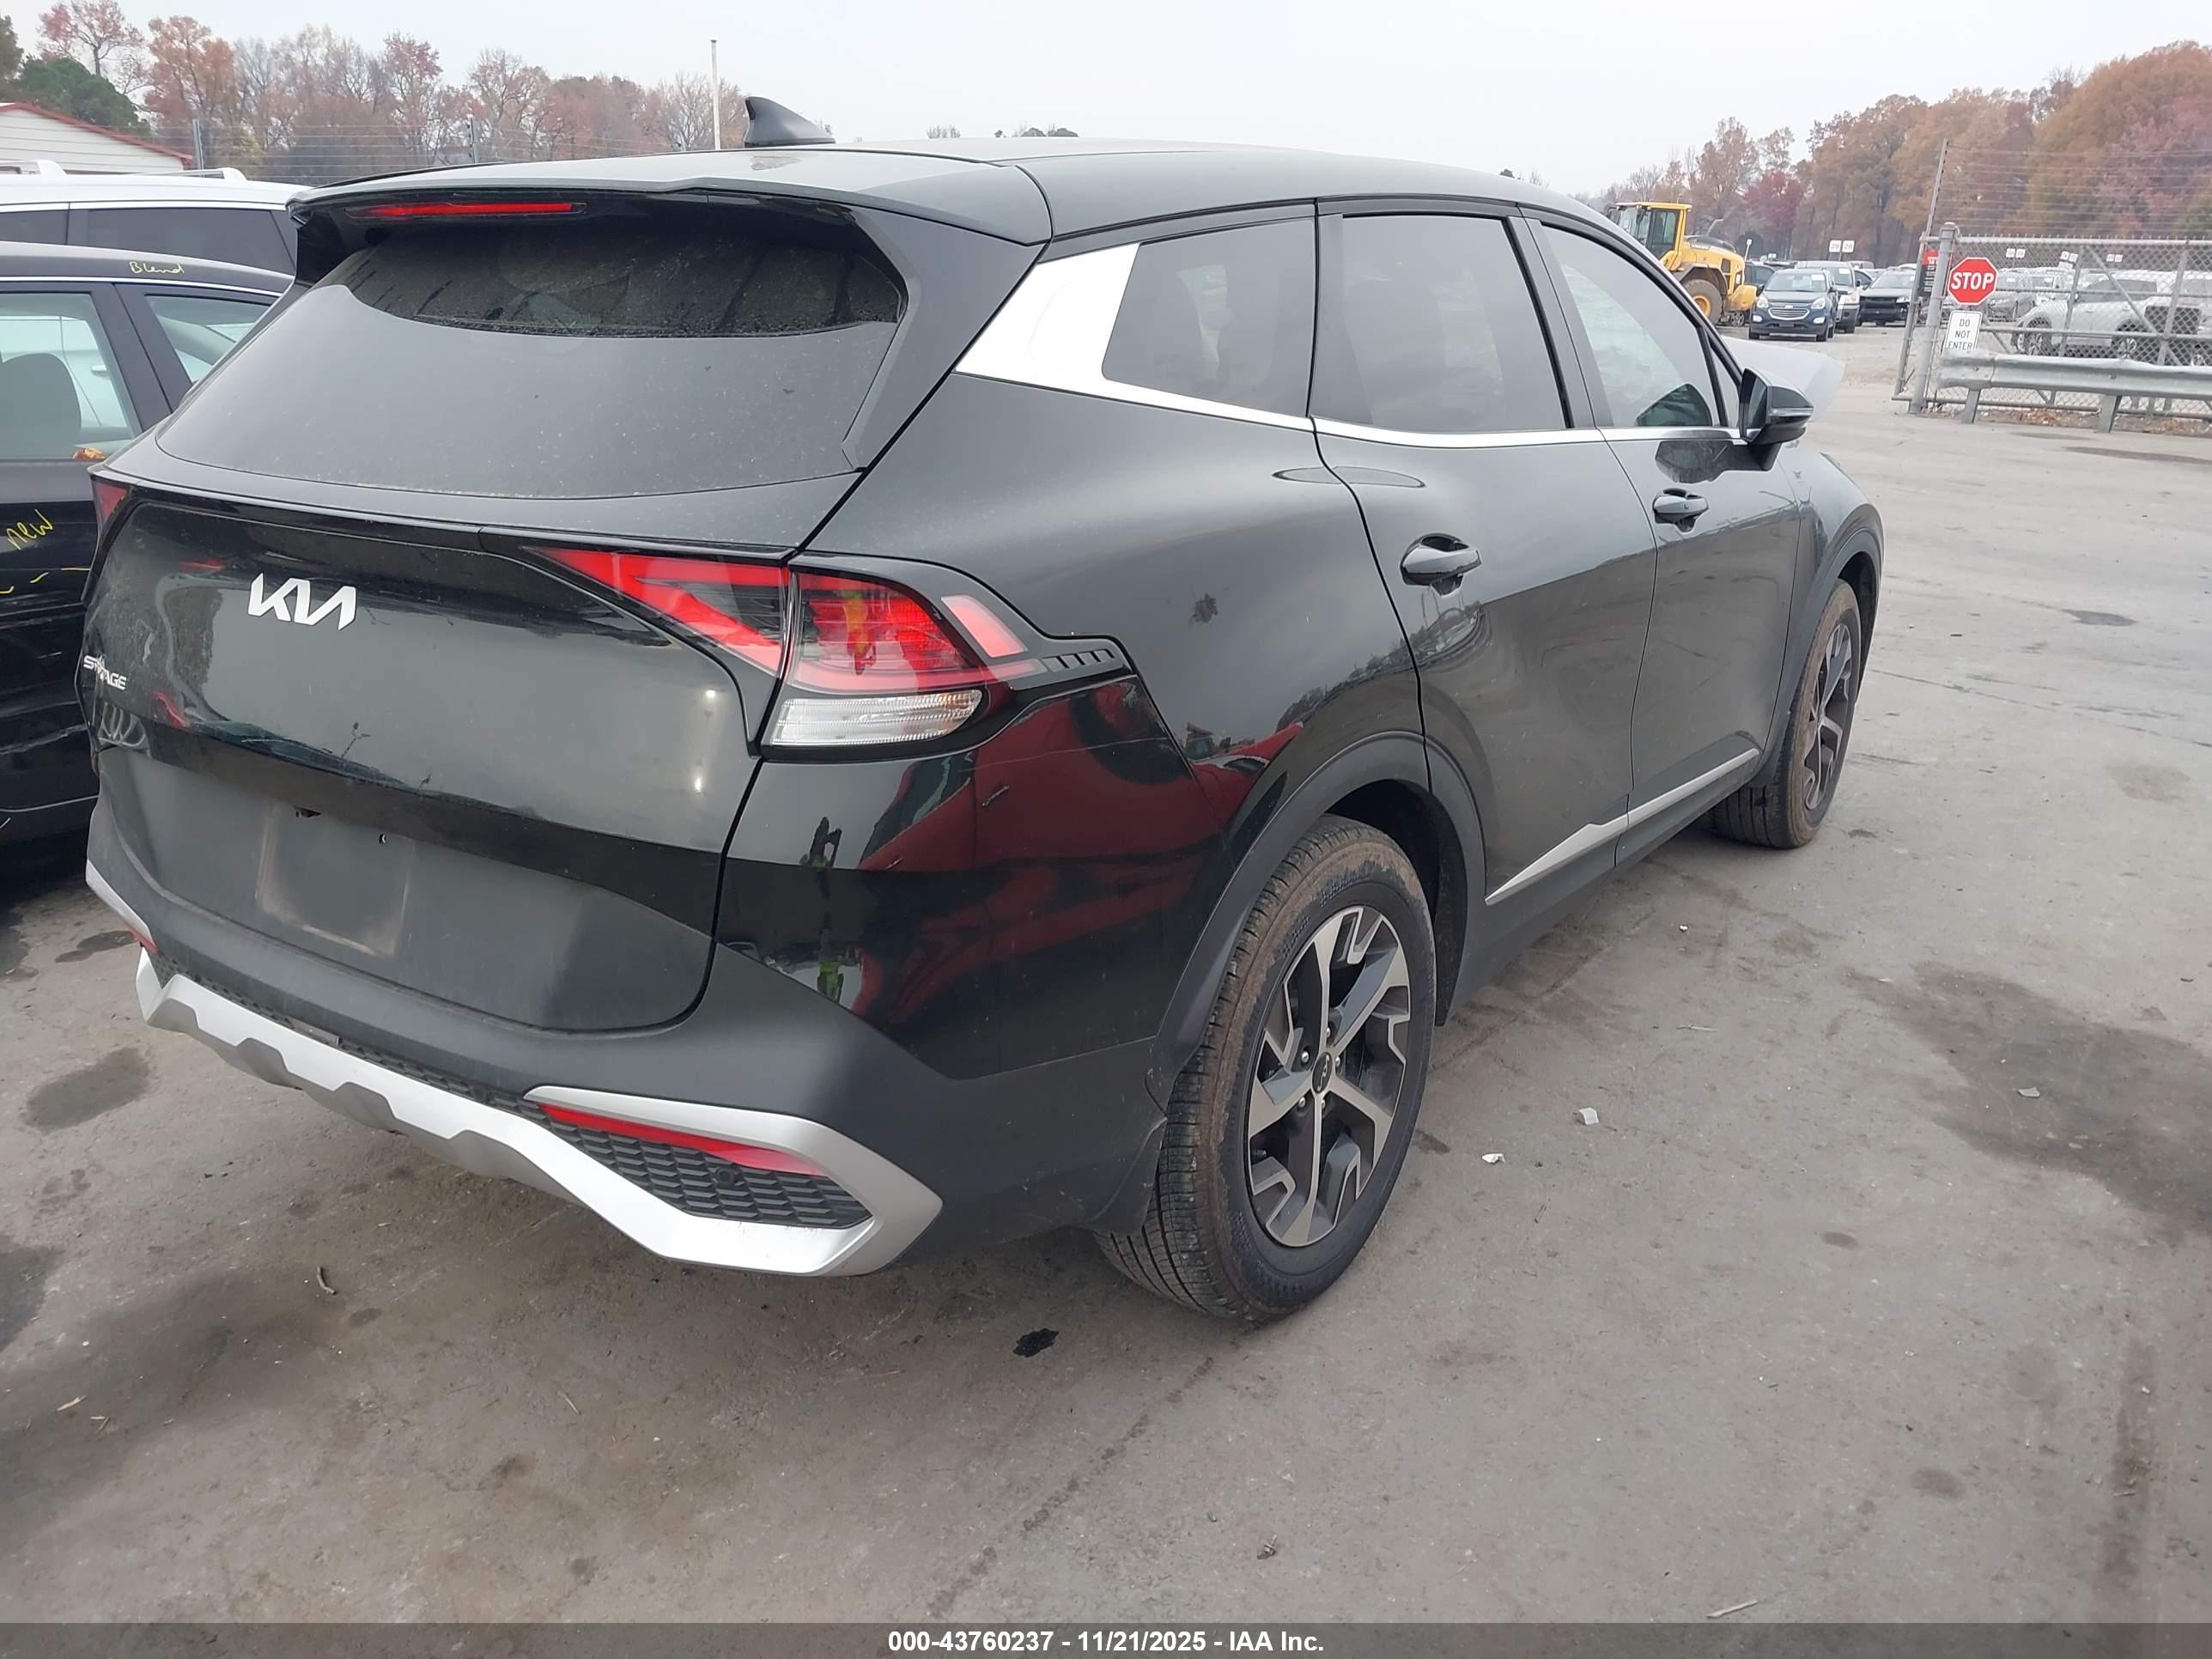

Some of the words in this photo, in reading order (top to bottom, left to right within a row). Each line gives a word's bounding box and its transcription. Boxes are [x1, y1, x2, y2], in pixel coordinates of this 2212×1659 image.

[1951, 271, 1995, 290] STOP
[1959, 318, 1971, 327] DO
[1954, 330, 1971, 338] NOT
[1948, 340, 1973, 351] ENTER
[248, 572, 356, 630] KIA
